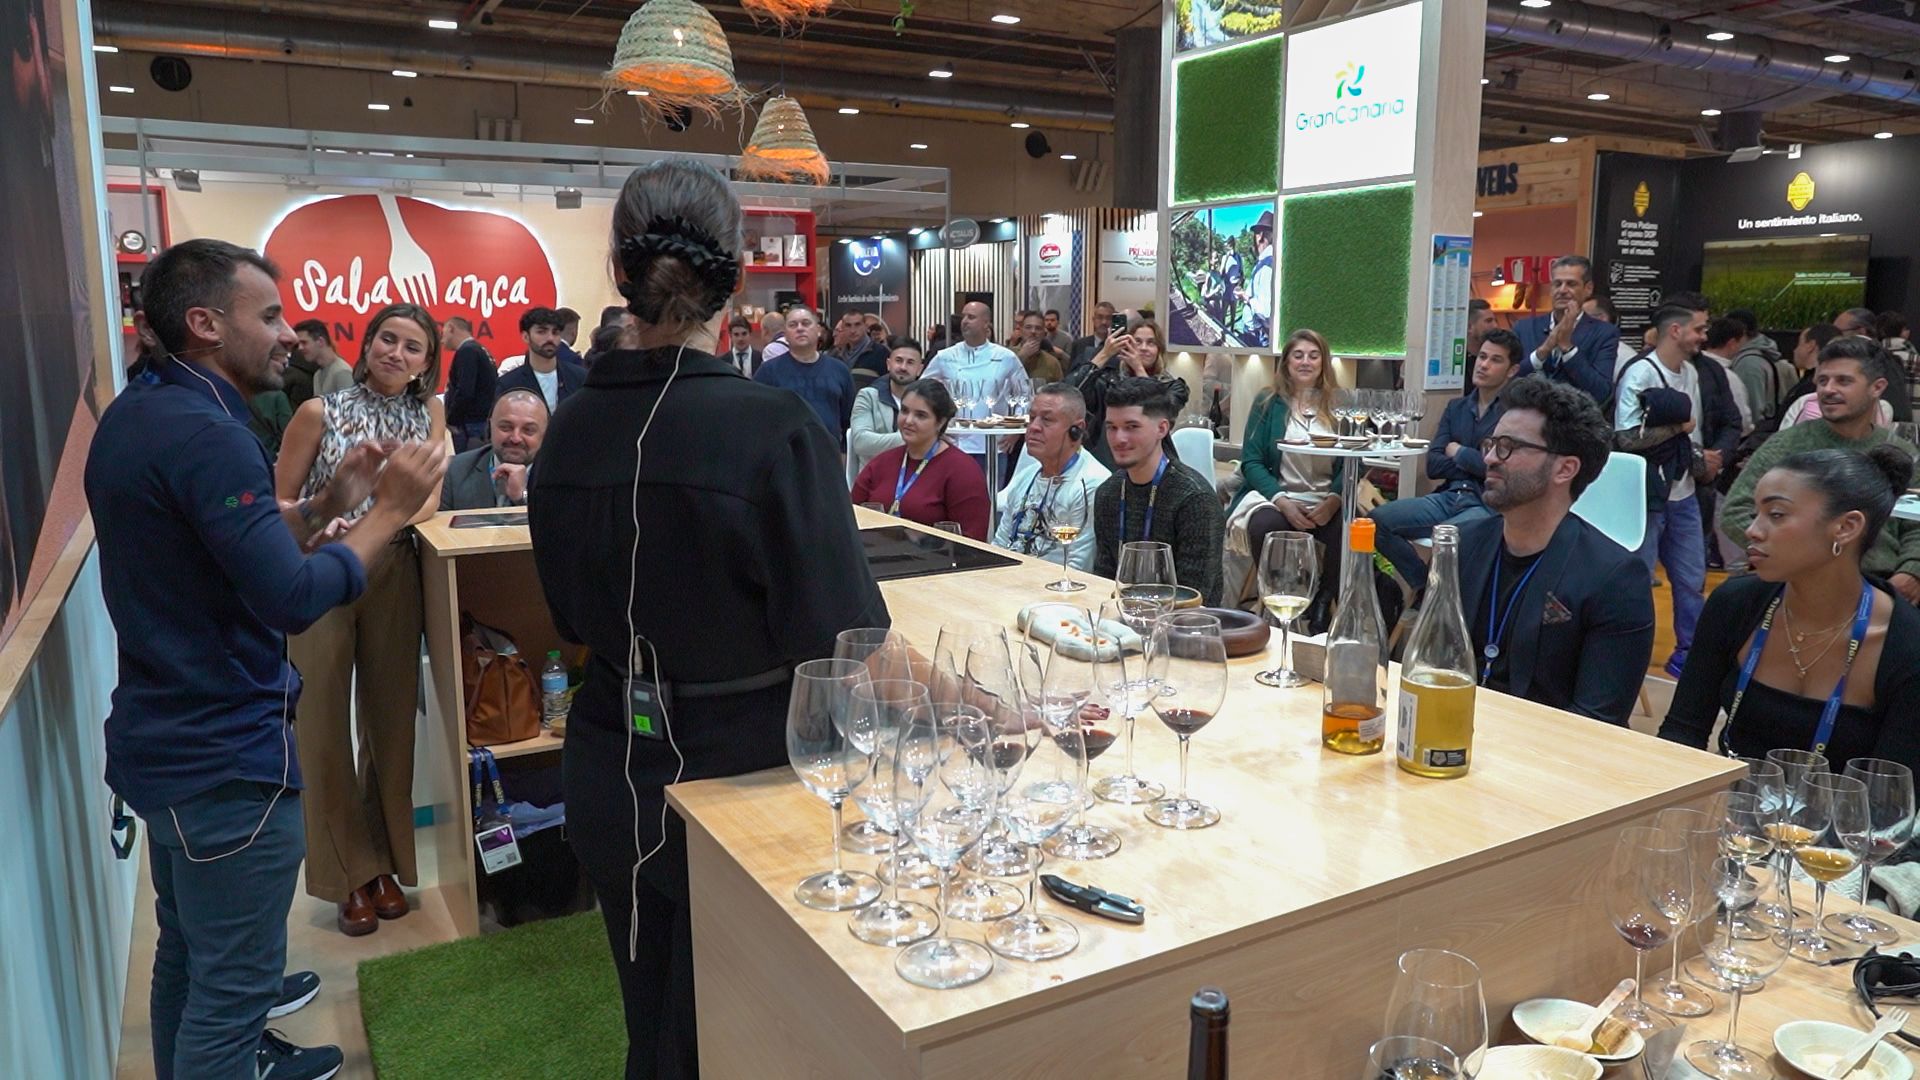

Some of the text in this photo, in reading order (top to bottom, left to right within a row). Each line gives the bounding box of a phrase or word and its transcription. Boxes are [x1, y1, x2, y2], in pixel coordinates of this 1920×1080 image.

[1738, 212, 1863, 229] Un sentimiento italiano.
